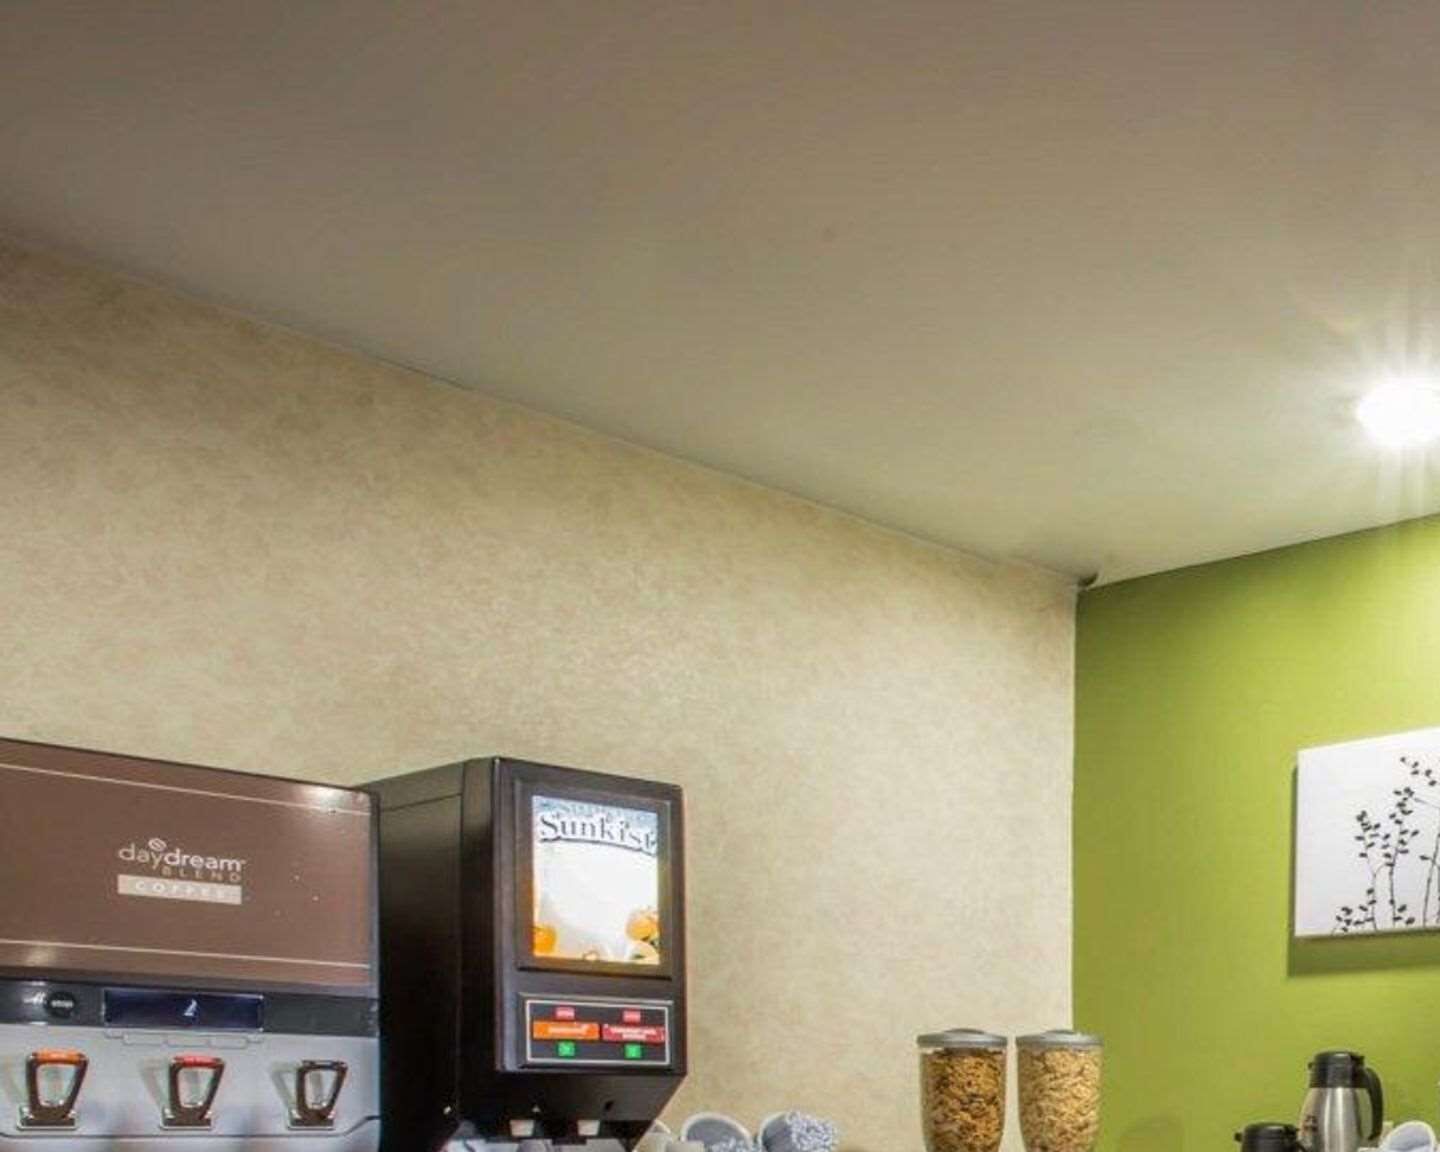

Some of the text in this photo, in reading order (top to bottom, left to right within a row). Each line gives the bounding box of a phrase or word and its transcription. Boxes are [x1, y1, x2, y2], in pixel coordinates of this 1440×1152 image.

[539, 814, 657, 850] Sunkist
[118, 843, 242, 872] daydream
[161, 864, 242, 883] BLEND
